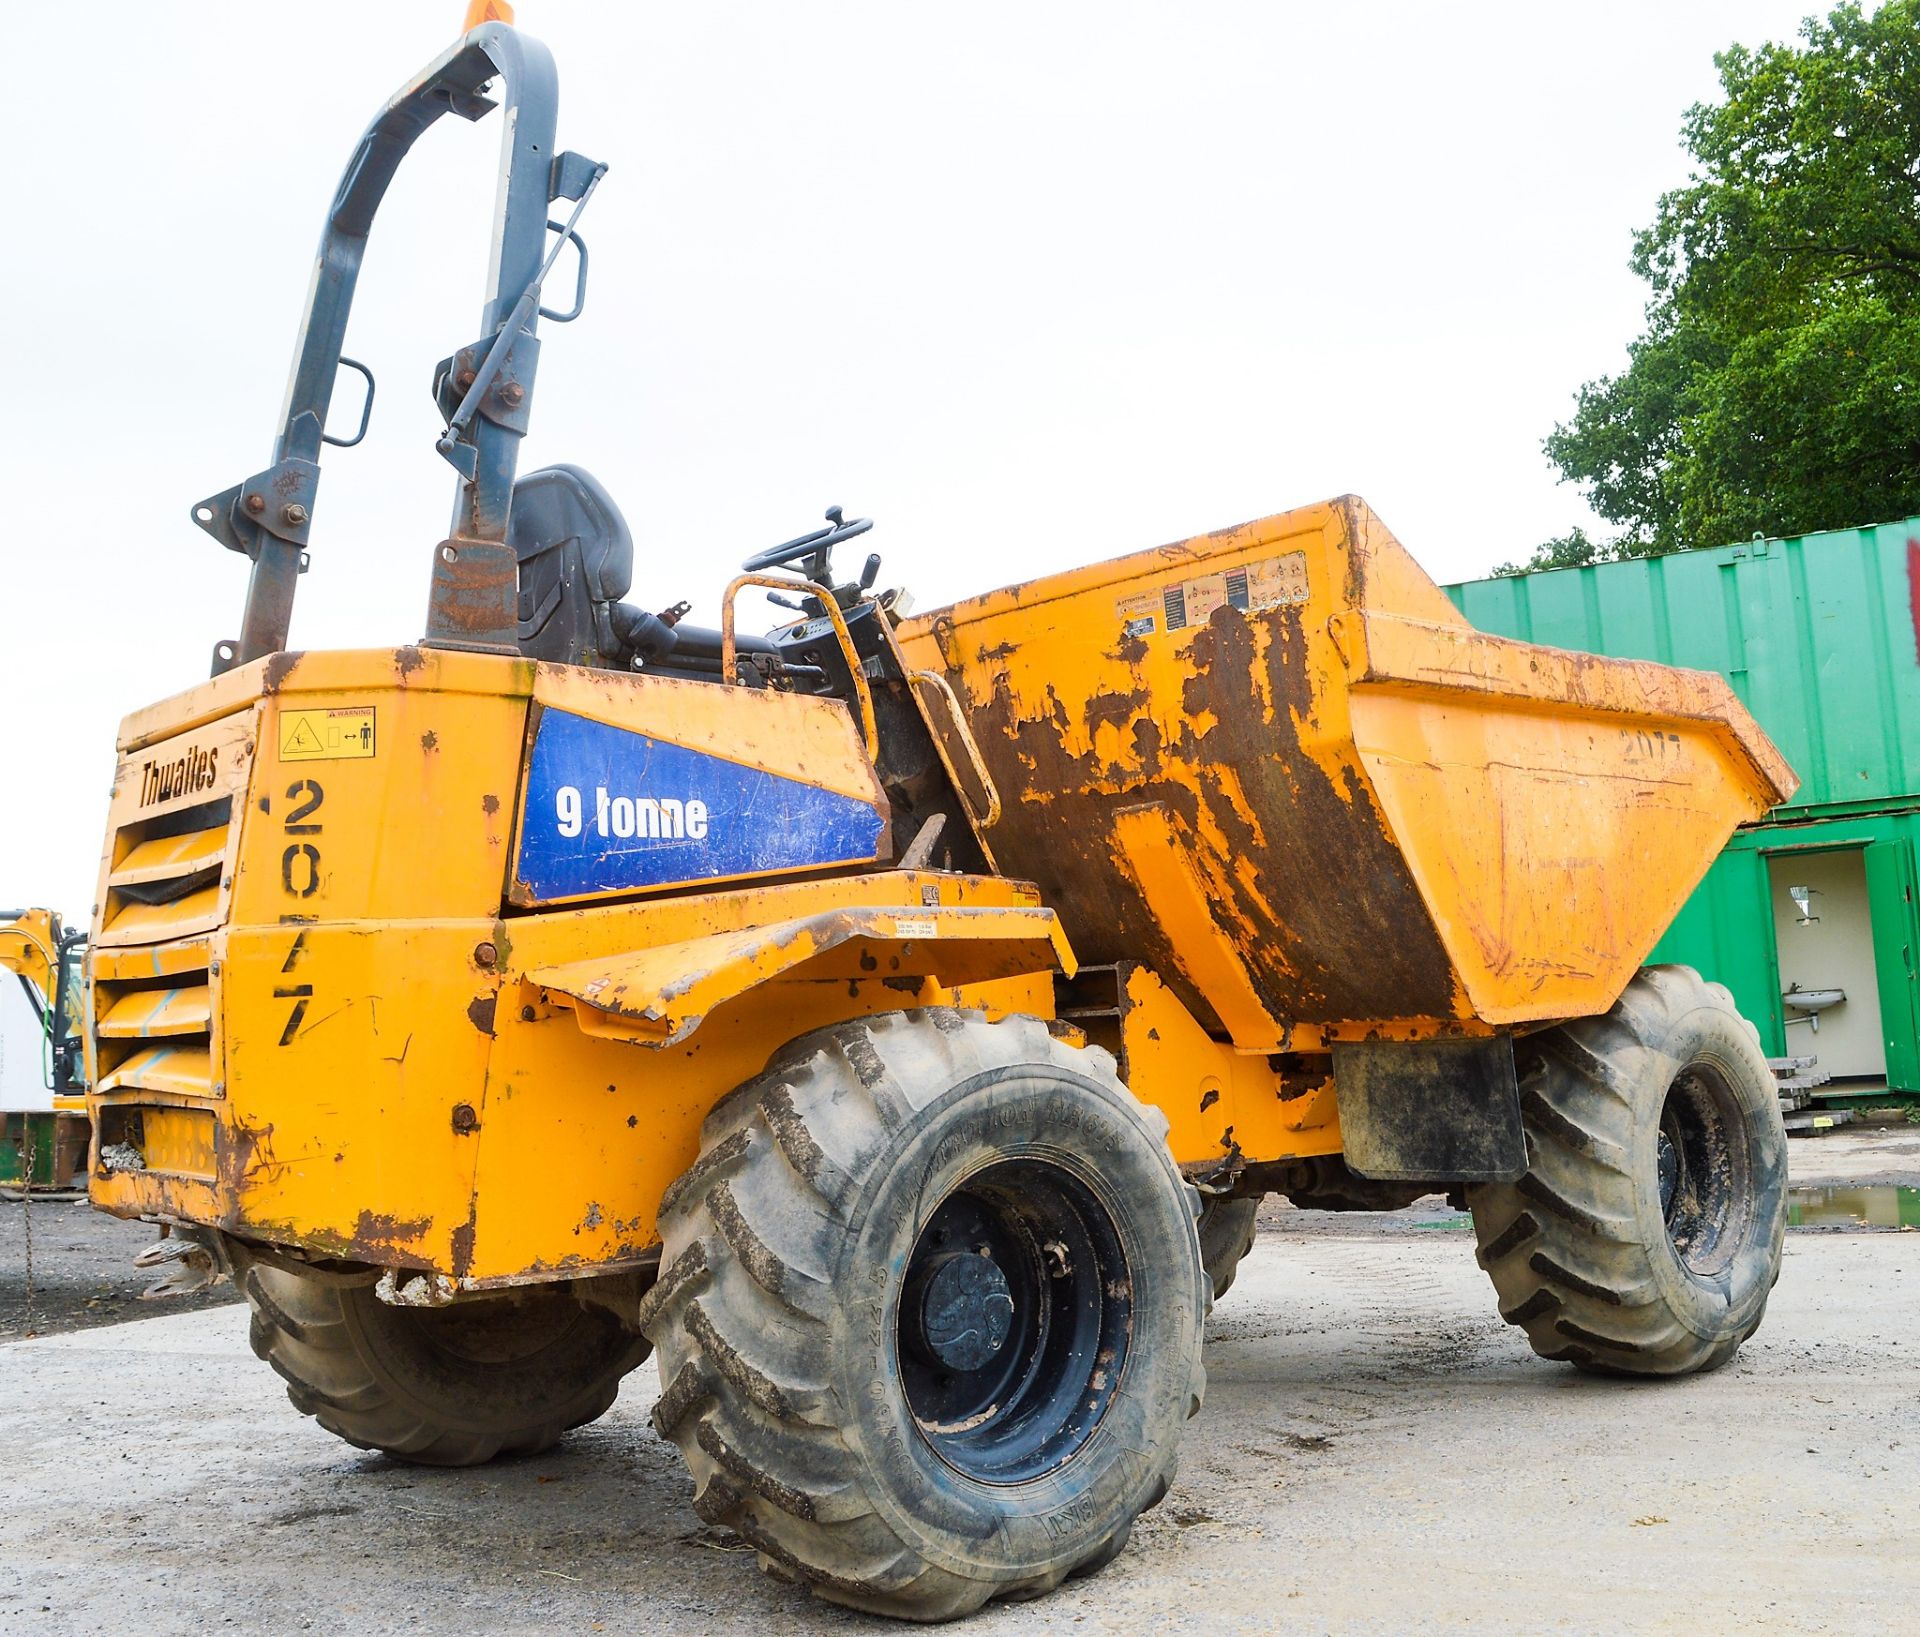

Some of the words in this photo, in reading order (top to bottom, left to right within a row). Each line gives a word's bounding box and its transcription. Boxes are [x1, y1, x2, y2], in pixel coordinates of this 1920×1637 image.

[338, 709, 370, 717] WARNING
[139, 745, 219, 809] Thwaites
[556, 786, 582, 838] 9
[596, 787, 708, 839] tonne
